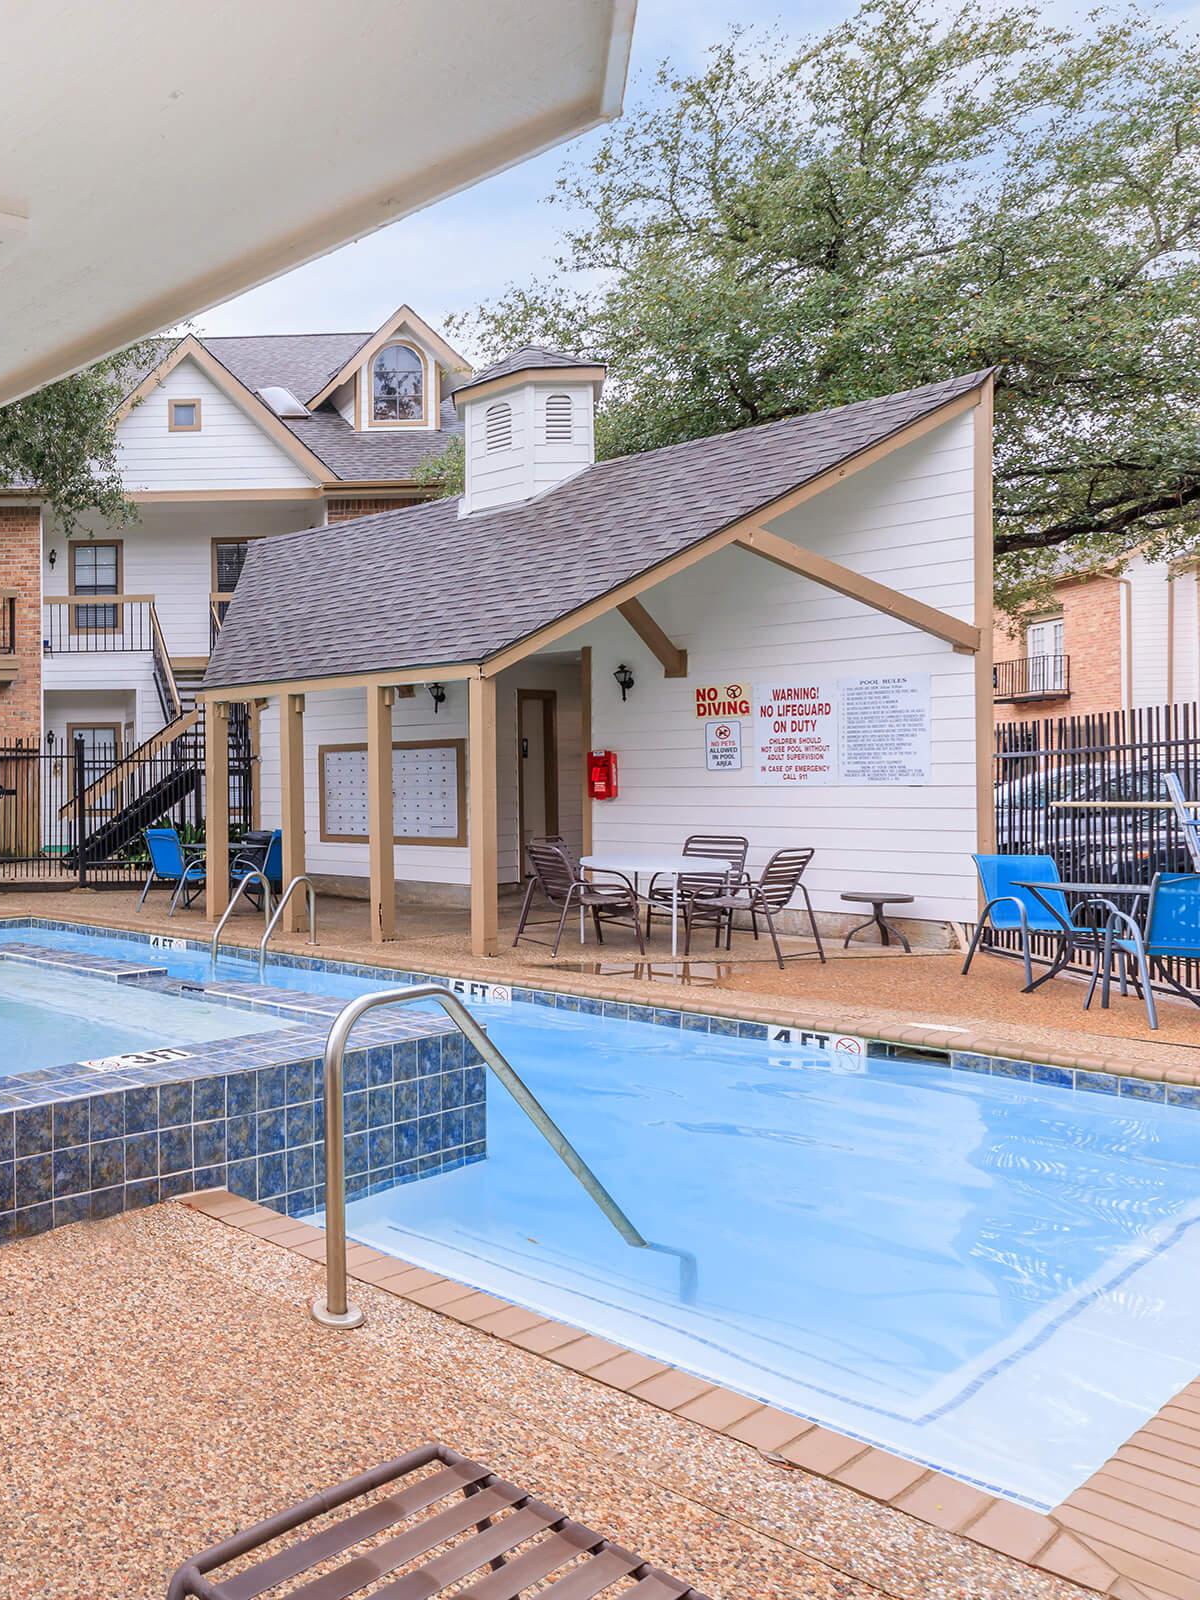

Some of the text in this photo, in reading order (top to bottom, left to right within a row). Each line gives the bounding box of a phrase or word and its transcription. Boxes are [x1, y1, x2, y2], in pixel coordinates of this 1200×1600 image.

[696, 687, 718, 702] NO
[772, 687, 819, 701] WARNING!
[697, 700, 750, 716] DIVING
[760, 705, 773, 718] NO
[778, 703, 831, 716] LIFEGUARD
[774, 720, 816, 733] ON DUTY
[454, 981, 489, 997] 5 FT
[773, 1029, 830, 1049] 4 FT
[121, 1049, 188, 1063] 3 FT
